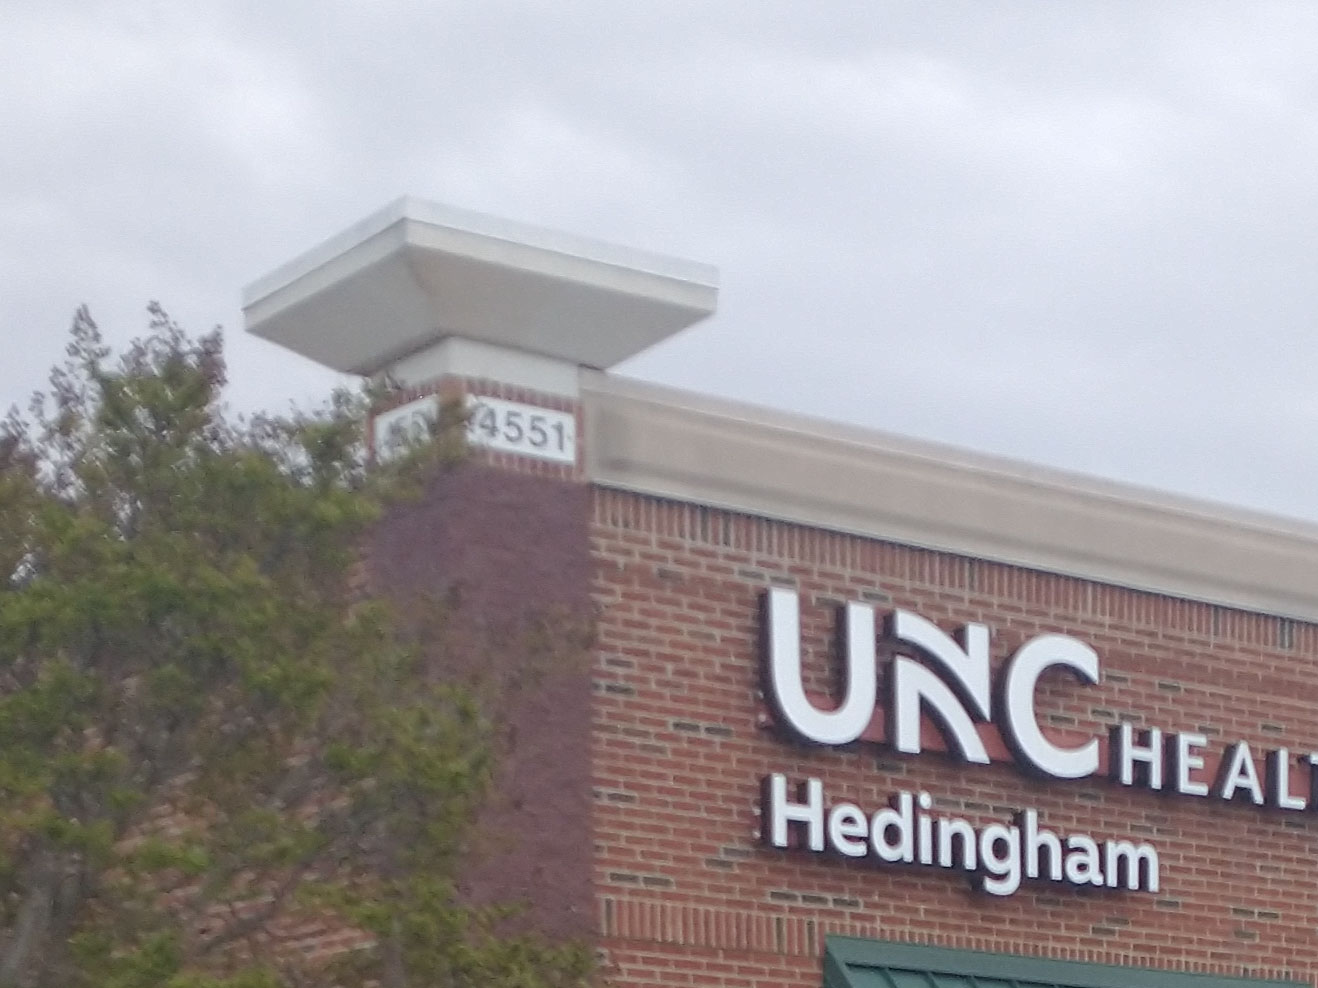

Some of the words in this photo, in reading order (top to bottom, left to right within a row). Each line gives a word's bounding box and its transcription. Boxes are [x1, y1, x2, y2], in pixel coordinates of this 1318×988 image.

[479, 407, 565, 453] 4551
[769, 586, 1099, 778] UNC
[770, 772, 1160, 895] Hedingham
